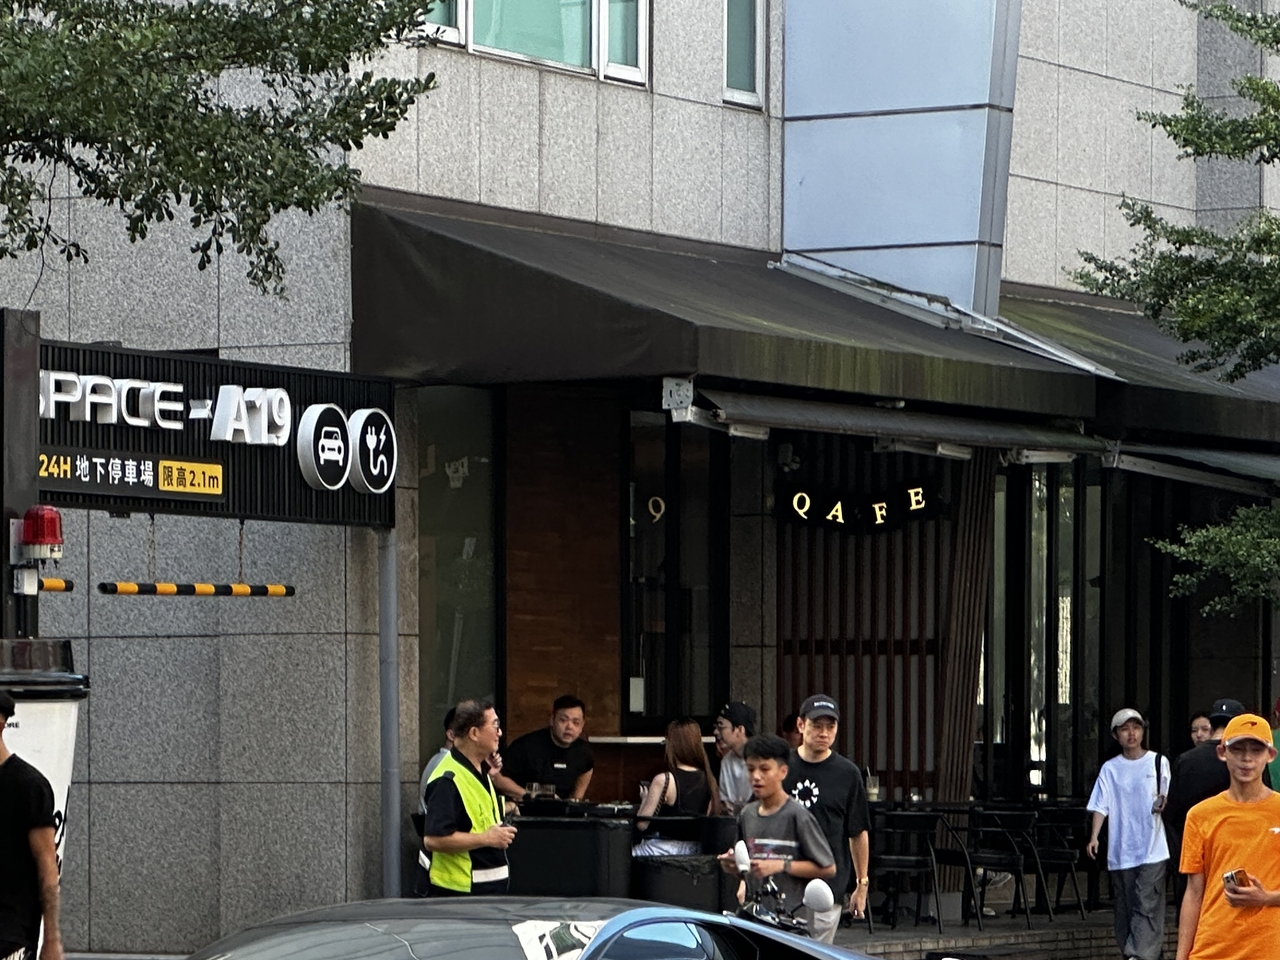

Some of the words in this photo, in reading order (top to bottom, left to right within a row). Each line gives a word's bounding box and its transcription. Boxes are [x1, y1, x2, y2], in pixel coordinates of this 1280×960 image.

[39, 368, 185, 431] PACE
[209, 384, 292, 447] A19
[38, 453, 72, 479] 24H
[75, 454, 154, 488] 地下停車場
[162, 464, 220, 490] 限高2.1m
[791, 487, 926, 525] QAFE
